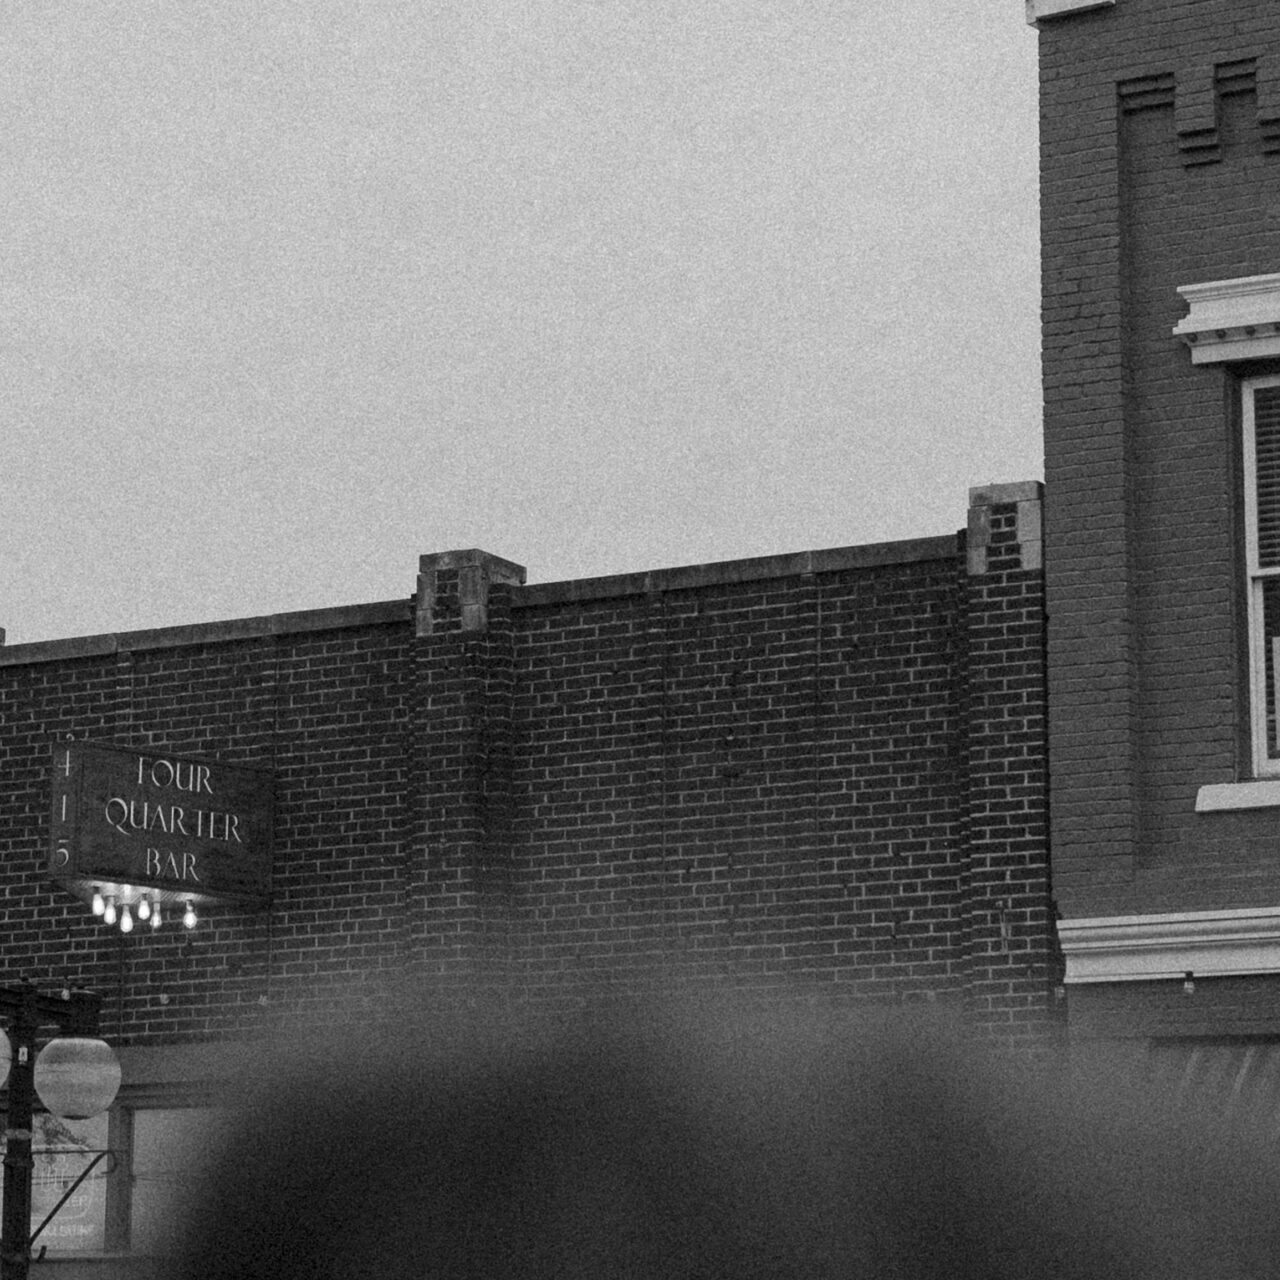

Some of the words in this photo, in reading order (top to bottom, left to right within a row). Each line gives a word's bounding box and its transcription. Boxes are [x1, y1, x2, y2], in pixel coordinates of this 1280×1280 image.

[138, 757, 213, 794] FOUR
[105, 797, 243, 843] QUARTER
[145, 848, 201, 882] BAR
